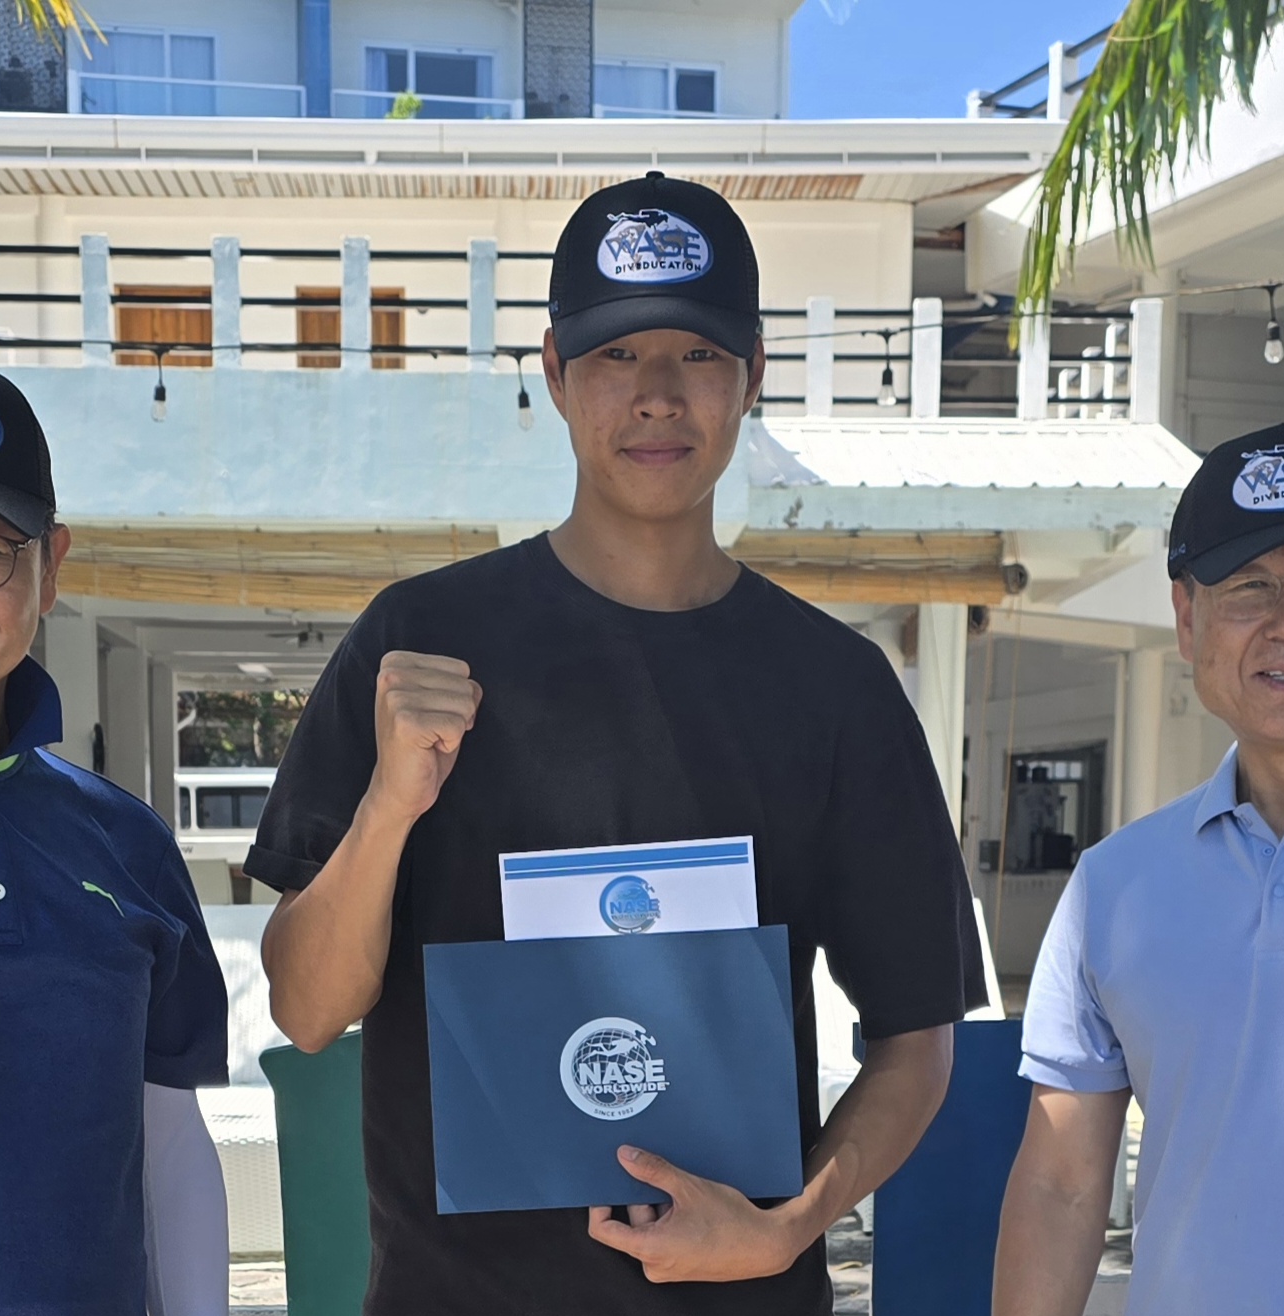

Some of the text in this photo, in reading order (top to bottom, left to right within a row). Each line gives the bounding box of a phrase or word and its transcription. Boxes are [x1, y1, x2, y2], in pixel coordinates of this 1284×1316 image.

[605, 226, 701, 261] WASE
[610, 898, 660, 914] NASE
[579, 1059, 666, 1085] NASE
[580, 1082, 667, 1095] WORLDWIDE
[594, 1108, 616, 1117] SINCE
